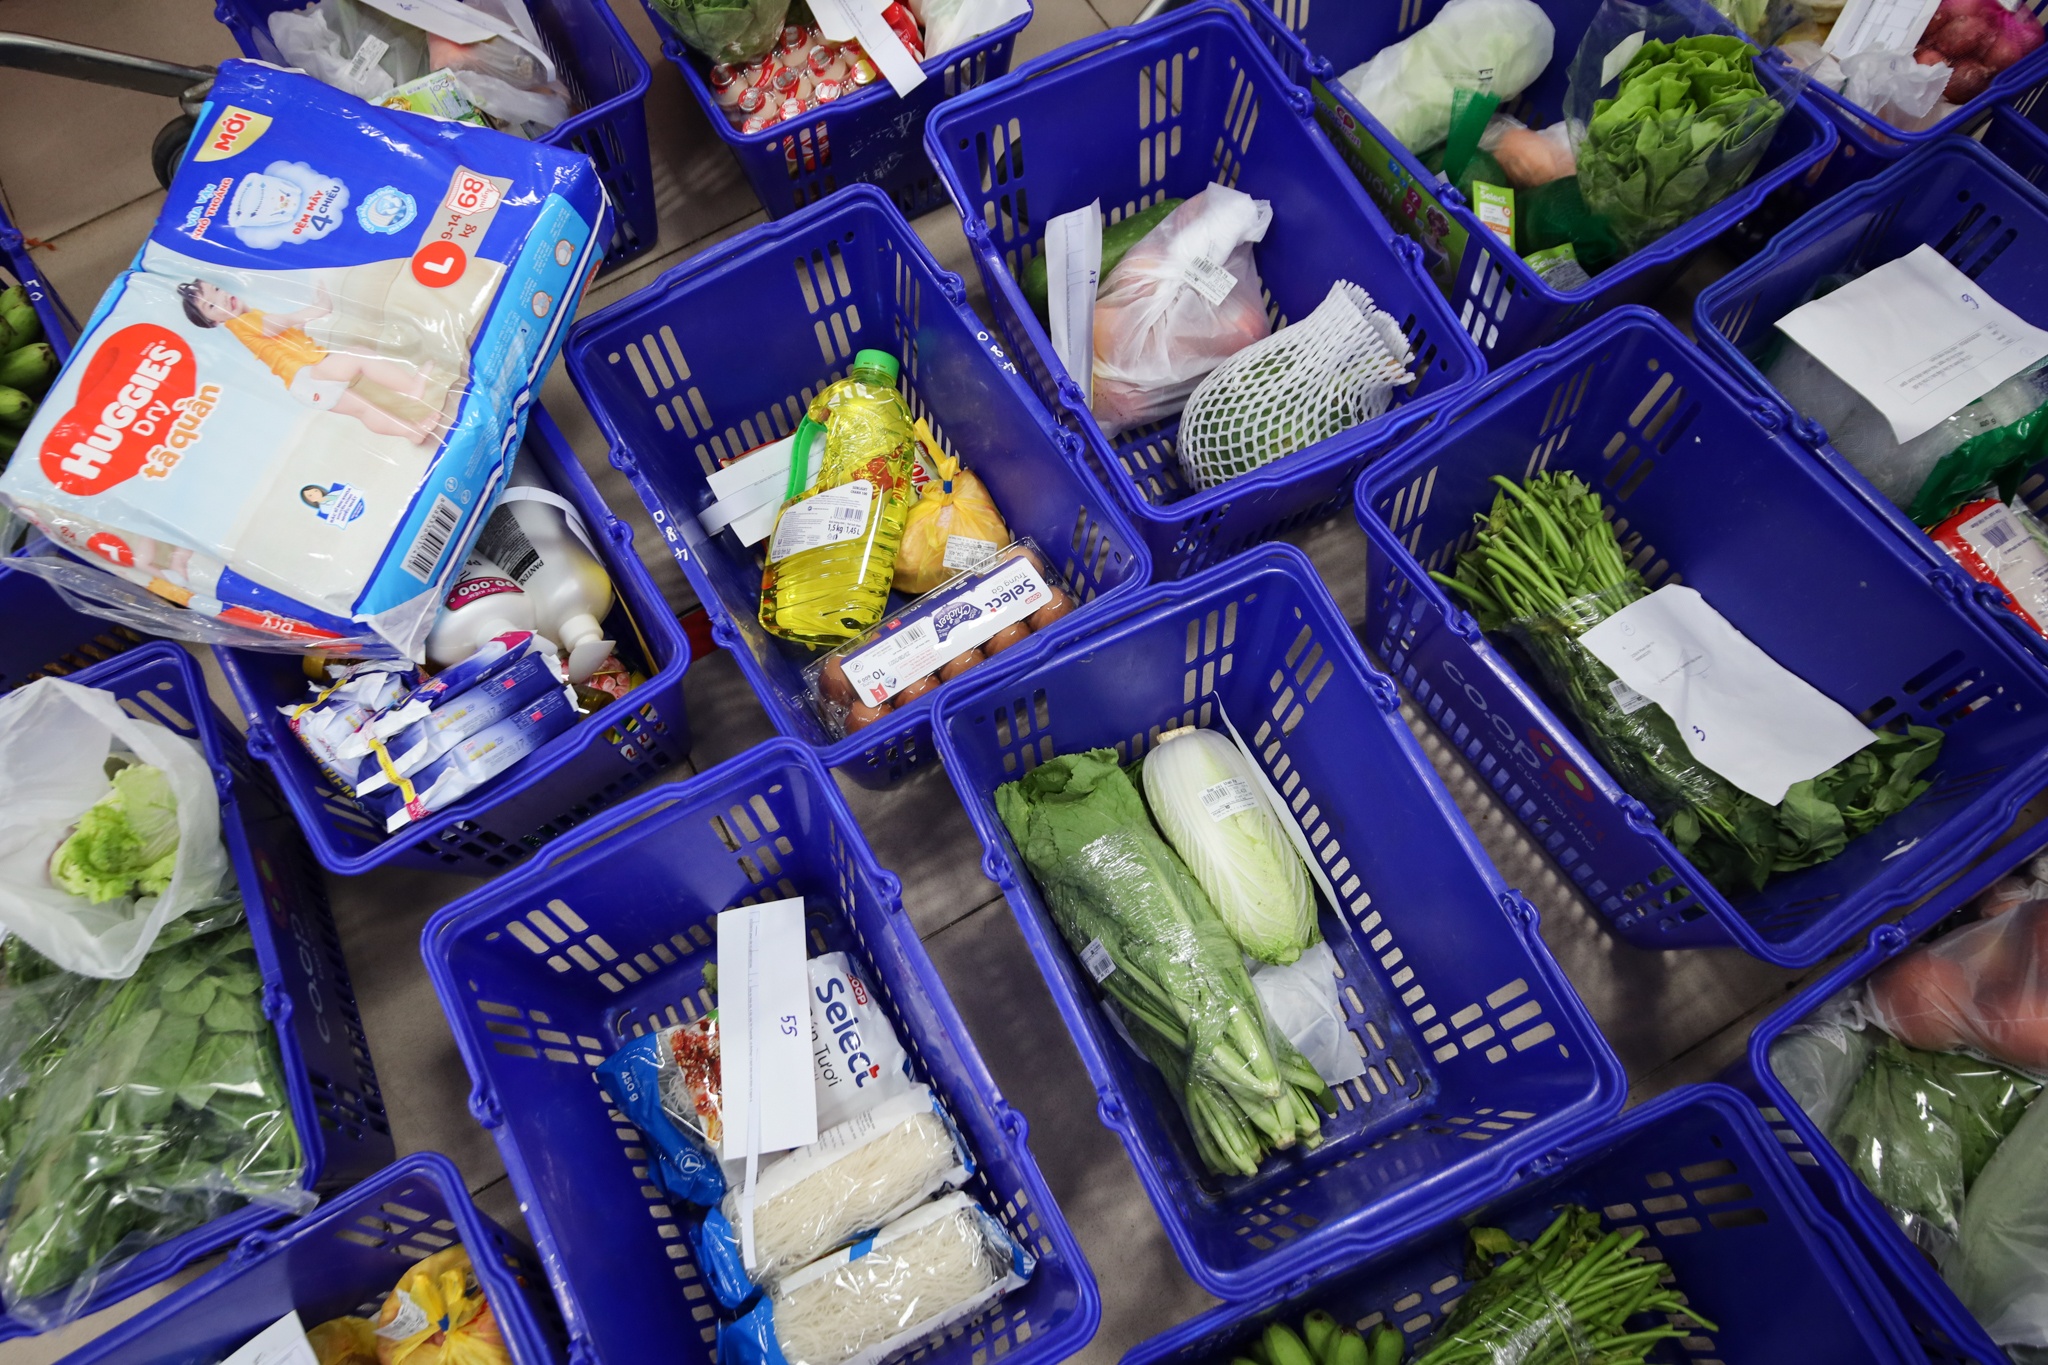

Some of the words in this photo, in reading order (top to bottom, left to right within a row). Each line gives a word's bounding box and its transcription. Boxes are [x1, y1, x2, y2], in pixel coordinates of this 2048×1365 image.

[209, 106, 251, 153] MỚI
[304, 189, 324, 212] MÂY
[454, 175, 485, 210] 68
[308, 209, 333, 233] 4
[440, 212, 462, 241] 9-14
[459, 221, 477, 240] kg
[423, 247, 454, 278] L
[61, 342, 180, 476] HUGGIES
[132, 396, 172, 441] Dry
[140, 443, 178, 484] tã
[159, 373, 225, 452] quần
[835, 525, 843, 533] kg
[518, 561, 542, 584] PANTENE
[1004, 571, 1025, 587] Trứng
[986, 577, 1034, 615] Select
[990, 583, 1004, 596] Gà
[871, 667, 885, 680] 10
[813, 978, 883, 1086] Select
[818, 1044, 842, 1086] Tươi
[620, 1070, 635, 1091] 450
[628, 1092, 639, 1102] g
